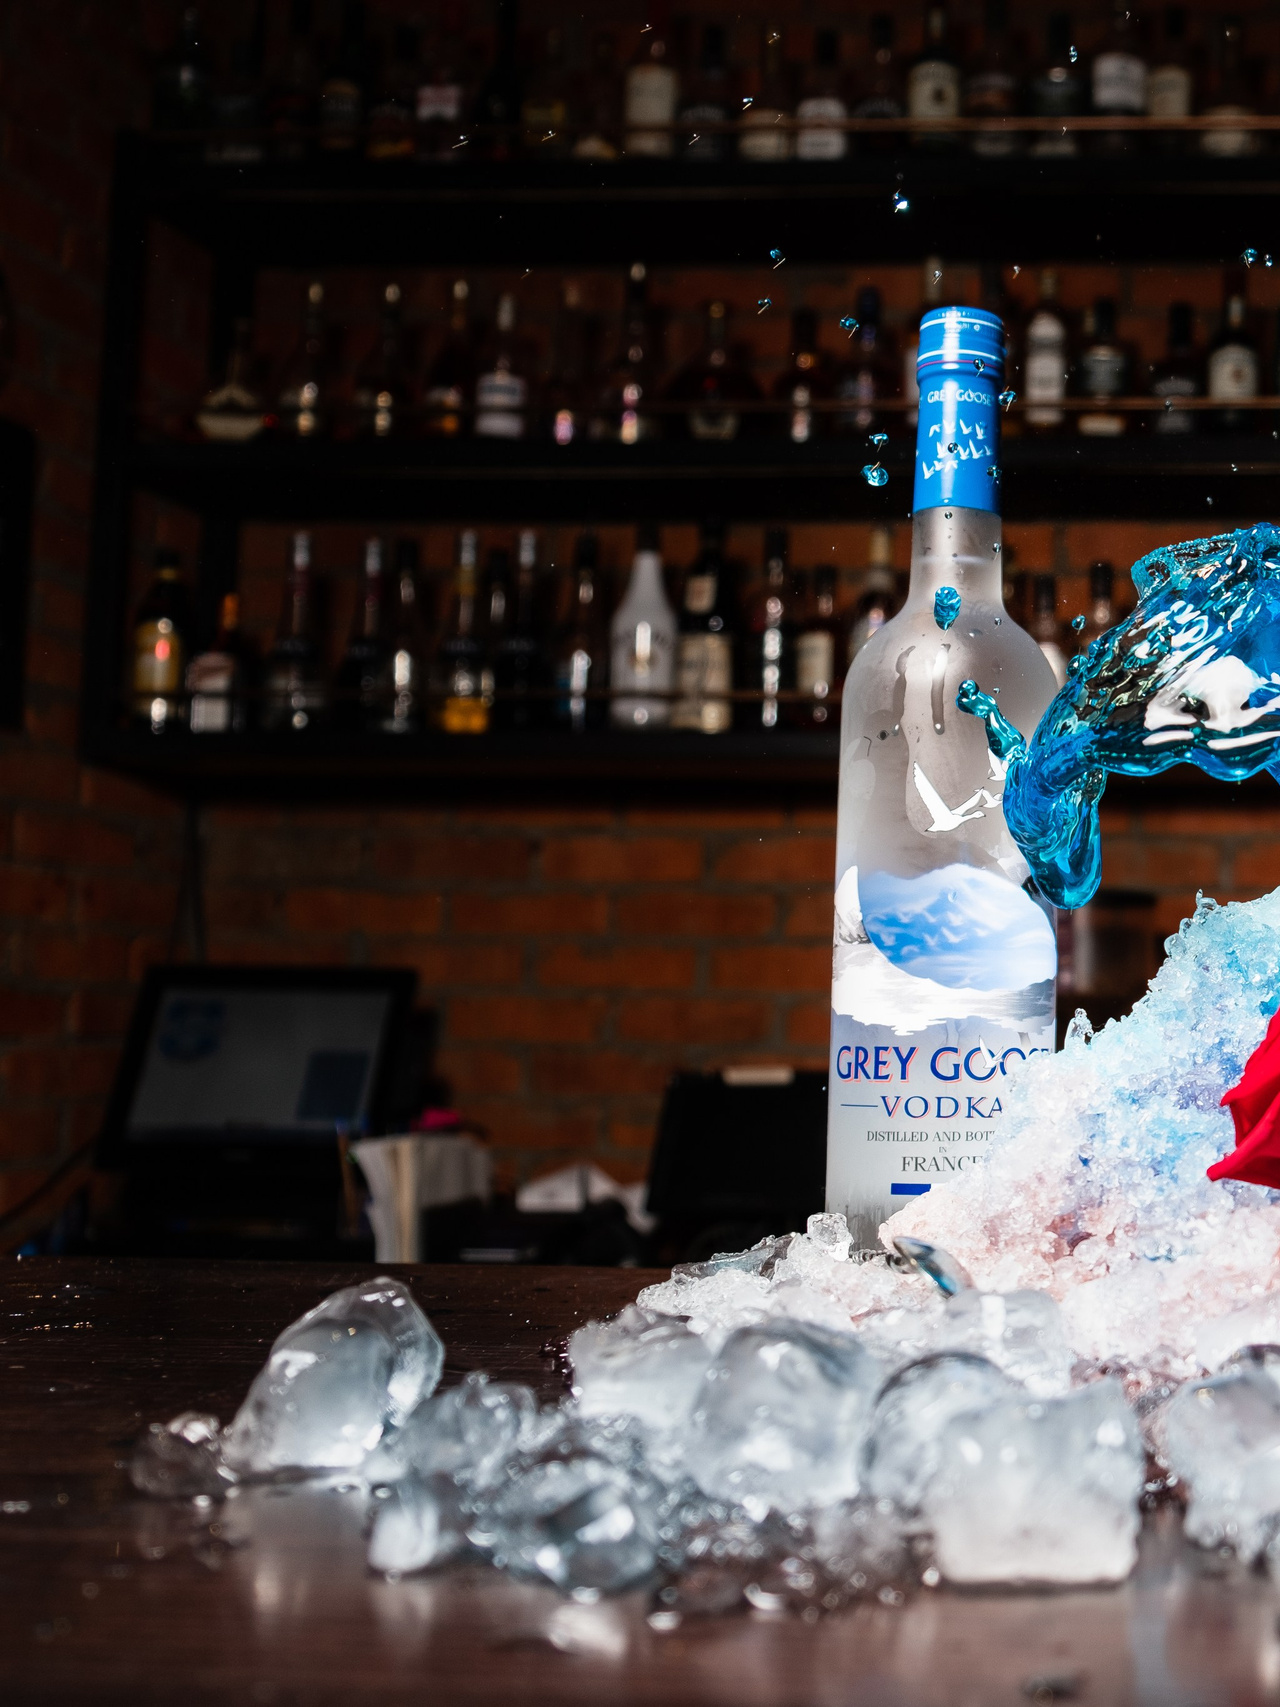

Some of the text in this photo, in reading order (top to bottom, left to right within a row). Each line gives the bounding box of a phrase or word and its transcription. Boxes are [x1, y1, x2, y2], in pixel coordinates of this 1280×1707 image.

[927, 389, 991, 406] GRE GOOSE
[837, 1045, 1050, 1083] GREY GOO
[880, 1095, 1003, 1119] VODKA
[866, 1130, 996, 1142] DISTILLED AND BOT
